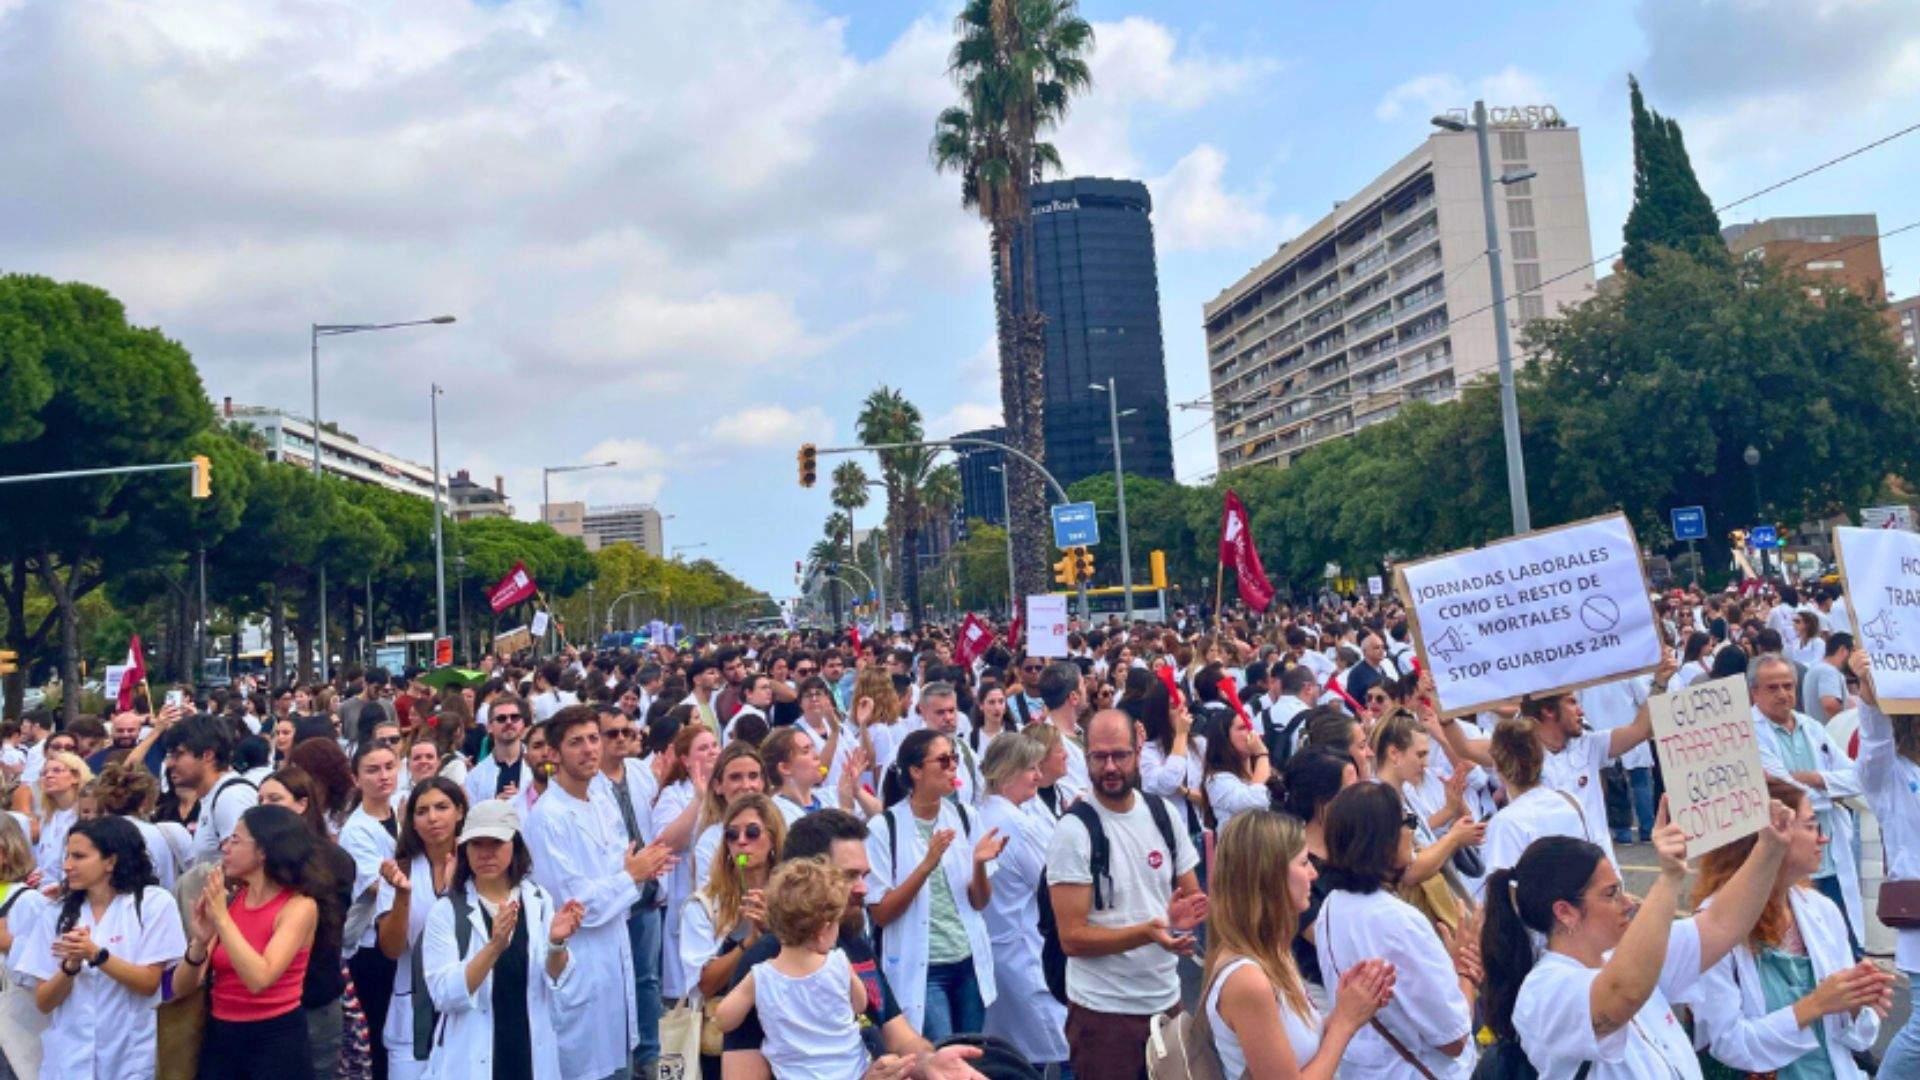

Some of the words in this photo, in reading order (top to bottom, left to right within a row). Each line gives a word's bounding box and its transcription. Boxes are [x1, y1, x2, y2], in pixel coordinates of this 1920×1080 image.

[1416, 570, 1505, 603] JORNADAS
[1508, 547, 1610, 582] LABORALES
[1439, 597, 1491, 620] COMO
[1496, 591, 1515, 608] EL
[1519, 582, 1573, 604] RESTO
[1577, 574, 1601, 591] DE
[1478, 605, 1572, 636] MORTALES
[1448, 660, 1491, 682] STOP
[1496, 644, 1586, 671] GUARDIAS
